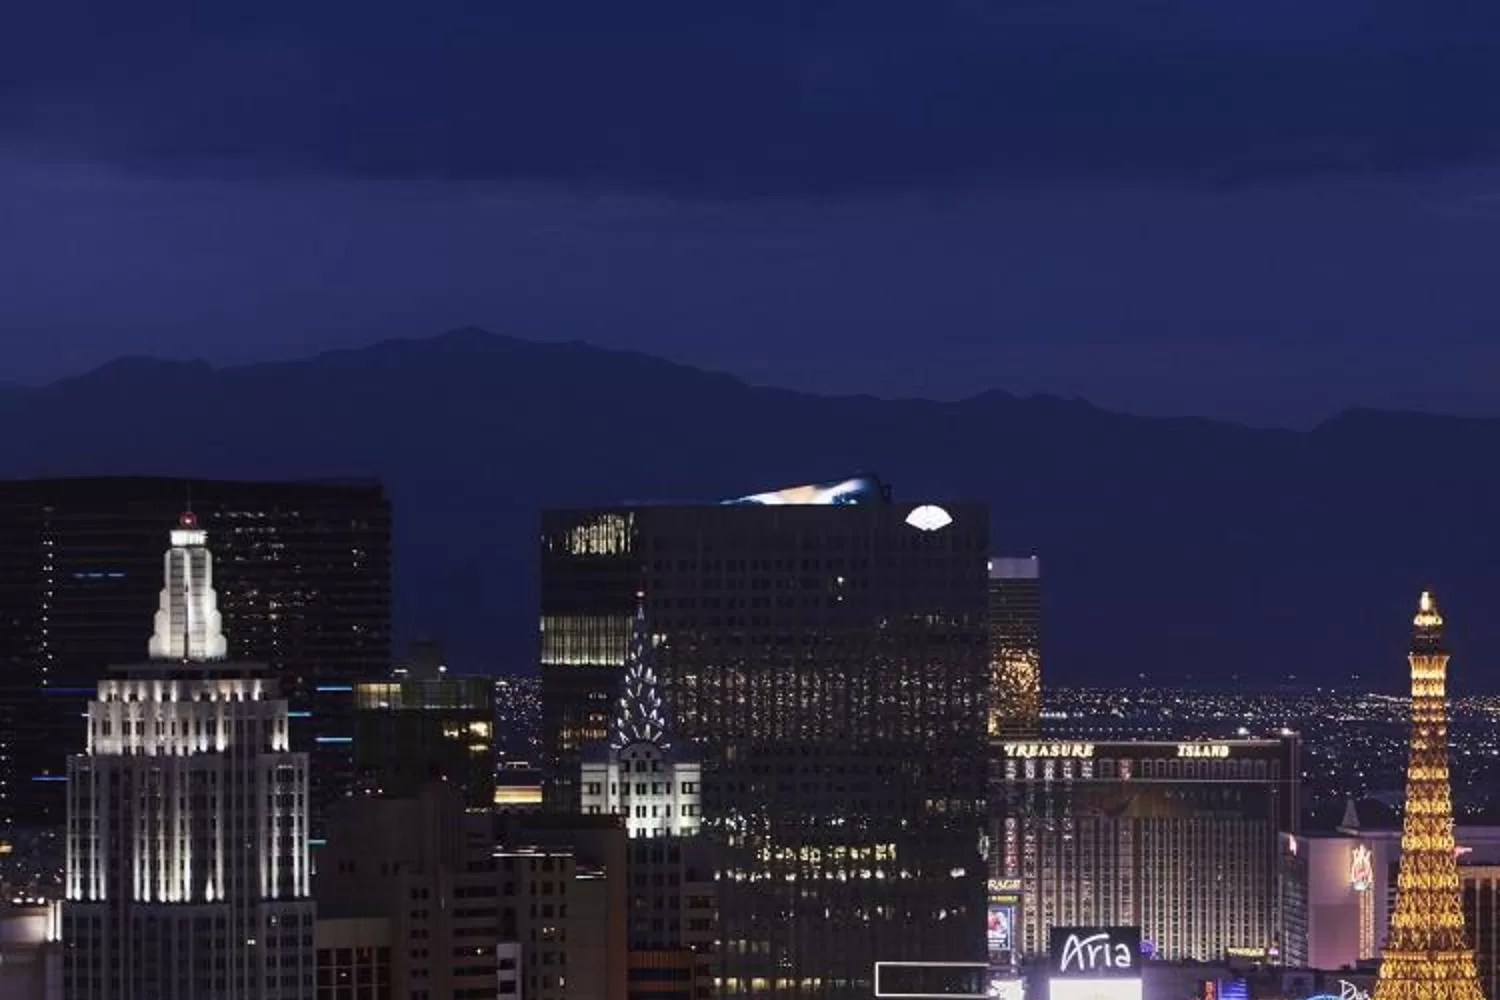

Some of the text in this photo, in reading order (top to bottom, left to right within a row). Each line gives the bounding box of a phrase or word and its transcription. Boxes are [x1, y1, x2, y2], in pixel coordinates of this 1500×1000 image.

[1004, 743, 1231, 759] TREASURE ISLAND
[1059, 932, 1132, 973] Aria
